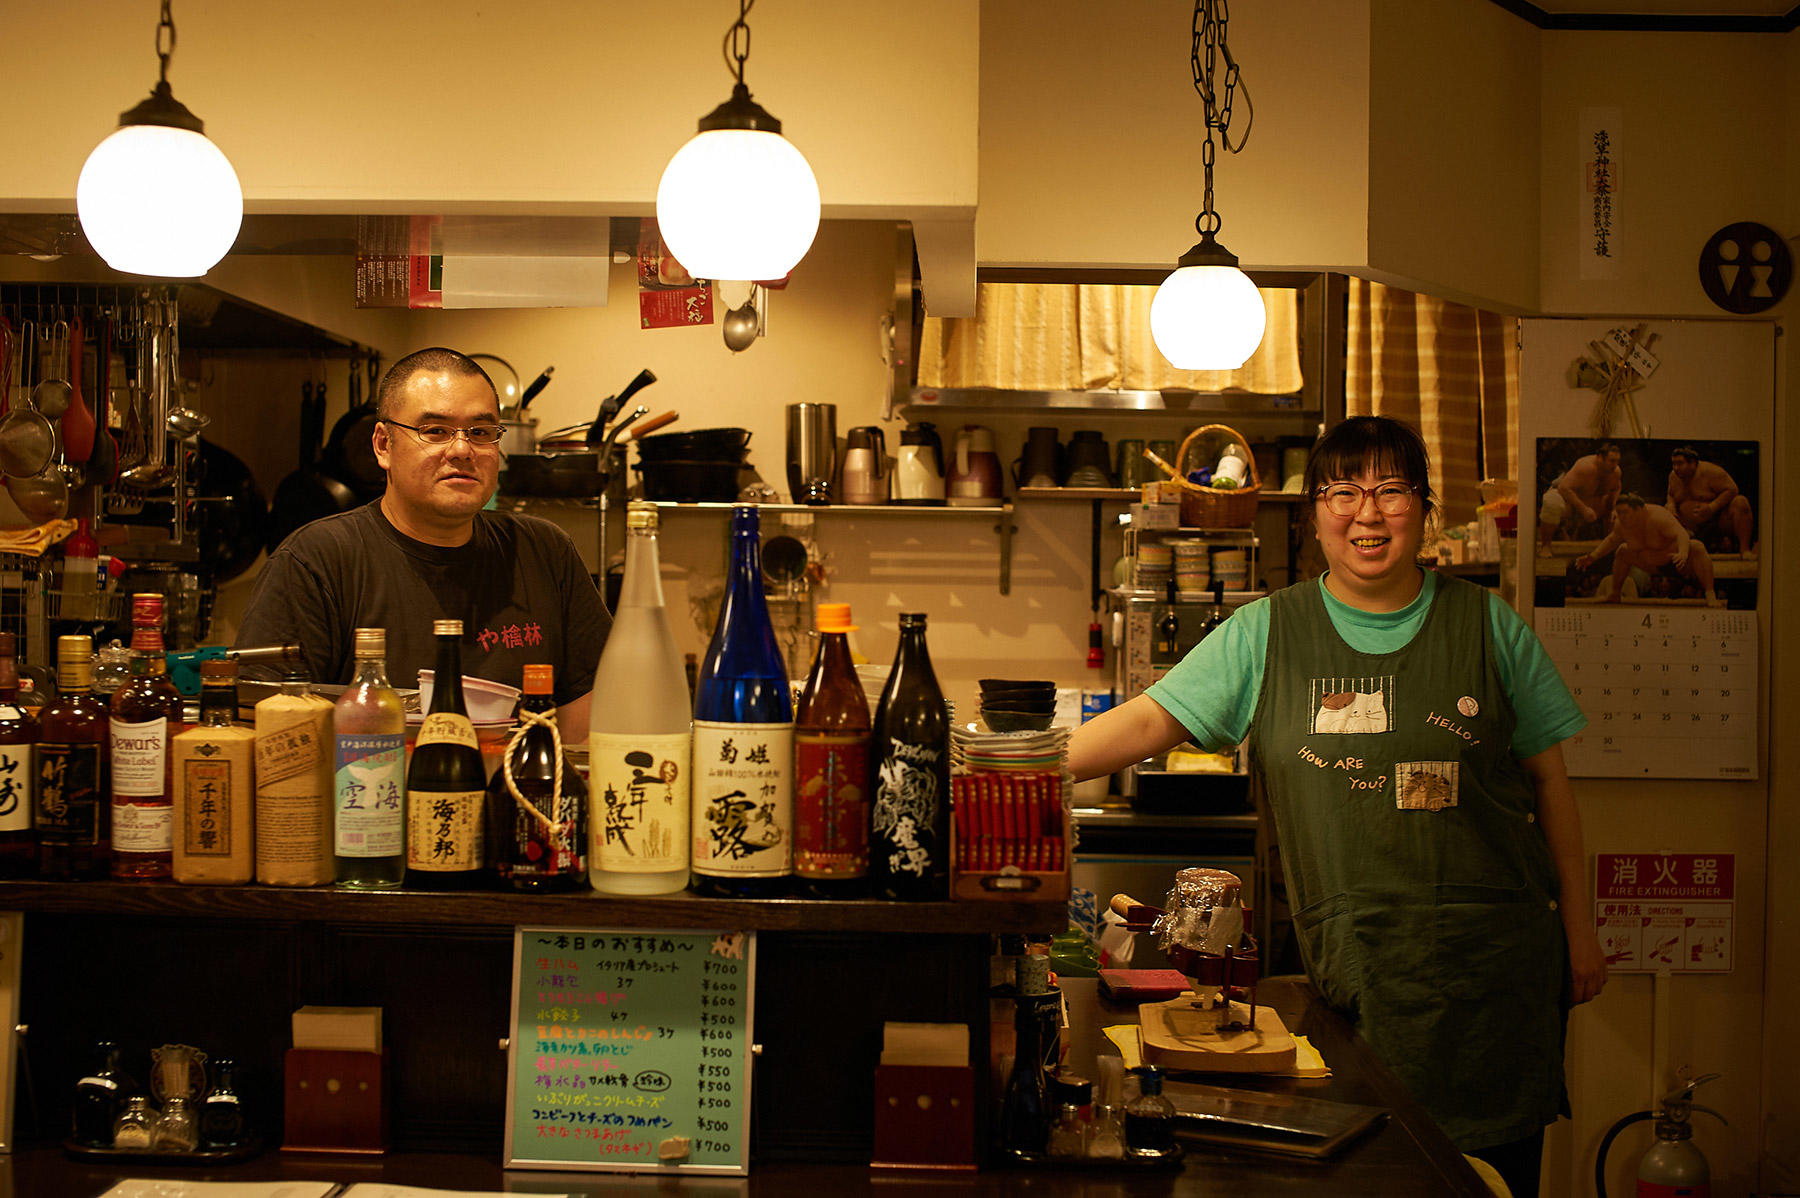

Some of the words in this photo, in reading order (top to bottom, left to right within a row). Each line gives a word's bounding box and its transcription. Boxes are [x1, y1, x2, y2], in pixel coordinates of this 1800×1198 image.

[1641, 613, 1652, 629] 4
[1425, 711, 1480, 747] HELLO!
[1297, 746, 1329, 769] HOW
[1333, 757, 1364, 771] ARE
[1348, 775, 1387, 793] YOU?
[340, 780, 400, 810] 空海
[1612, 857, 1719, 886] 消火器
[1608, 886, 1633, 896] FIRE
[1637, 886, 1721, 896] EXTINGUISHER
[1604, 904, 1641, 917] 使用法
[535, 957, 580, 972] 生ハム
[703, 961, 738, 975] ¥700
[702, 979, 737, 992] ¥600
[701, 995, 736, 1008] ¥600
[700, 1012, 735, 1026] ¥500
[700, 1028, 733, 1041] ¥600
[701, 1045, 732, 1059] ¥500
[698, 1079, 732, 1092] ¥500
[698, 1097, 731, 1110] ¥500
[696, 1115, 729, 1133] ¥500
[695, 1139, 731, 1154] ¥700
